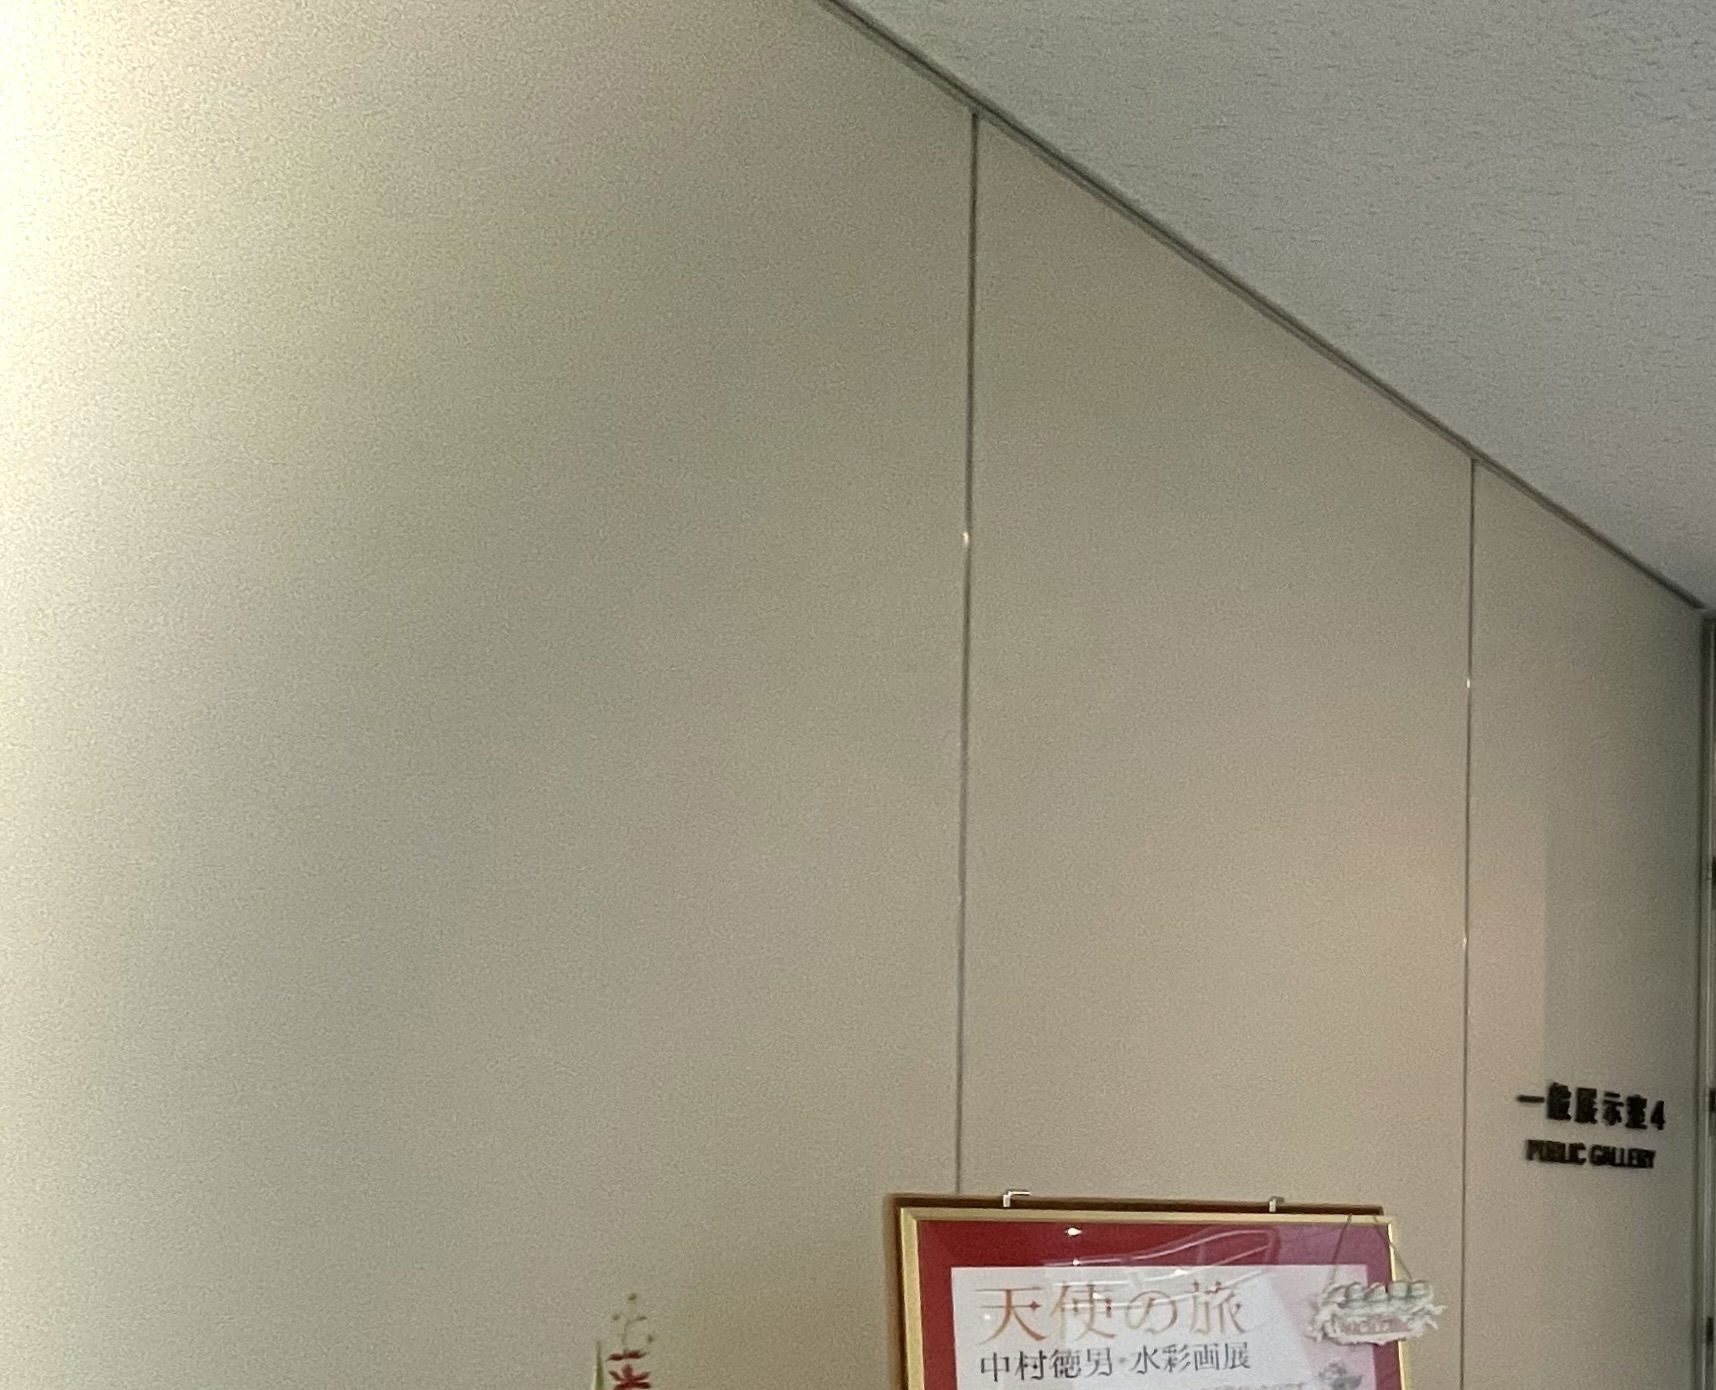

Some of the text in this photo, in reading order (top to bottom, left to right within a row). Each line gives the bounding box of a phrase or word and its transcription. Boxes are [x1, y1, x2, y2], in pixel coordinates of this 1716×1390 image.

[1517, 1082, 1666, 1130] 一般展示室4
[1525, 1139, 1657, 1169] PUBLIC GALLERY
[976, 1280, 1248, 1345] 天使の旅
